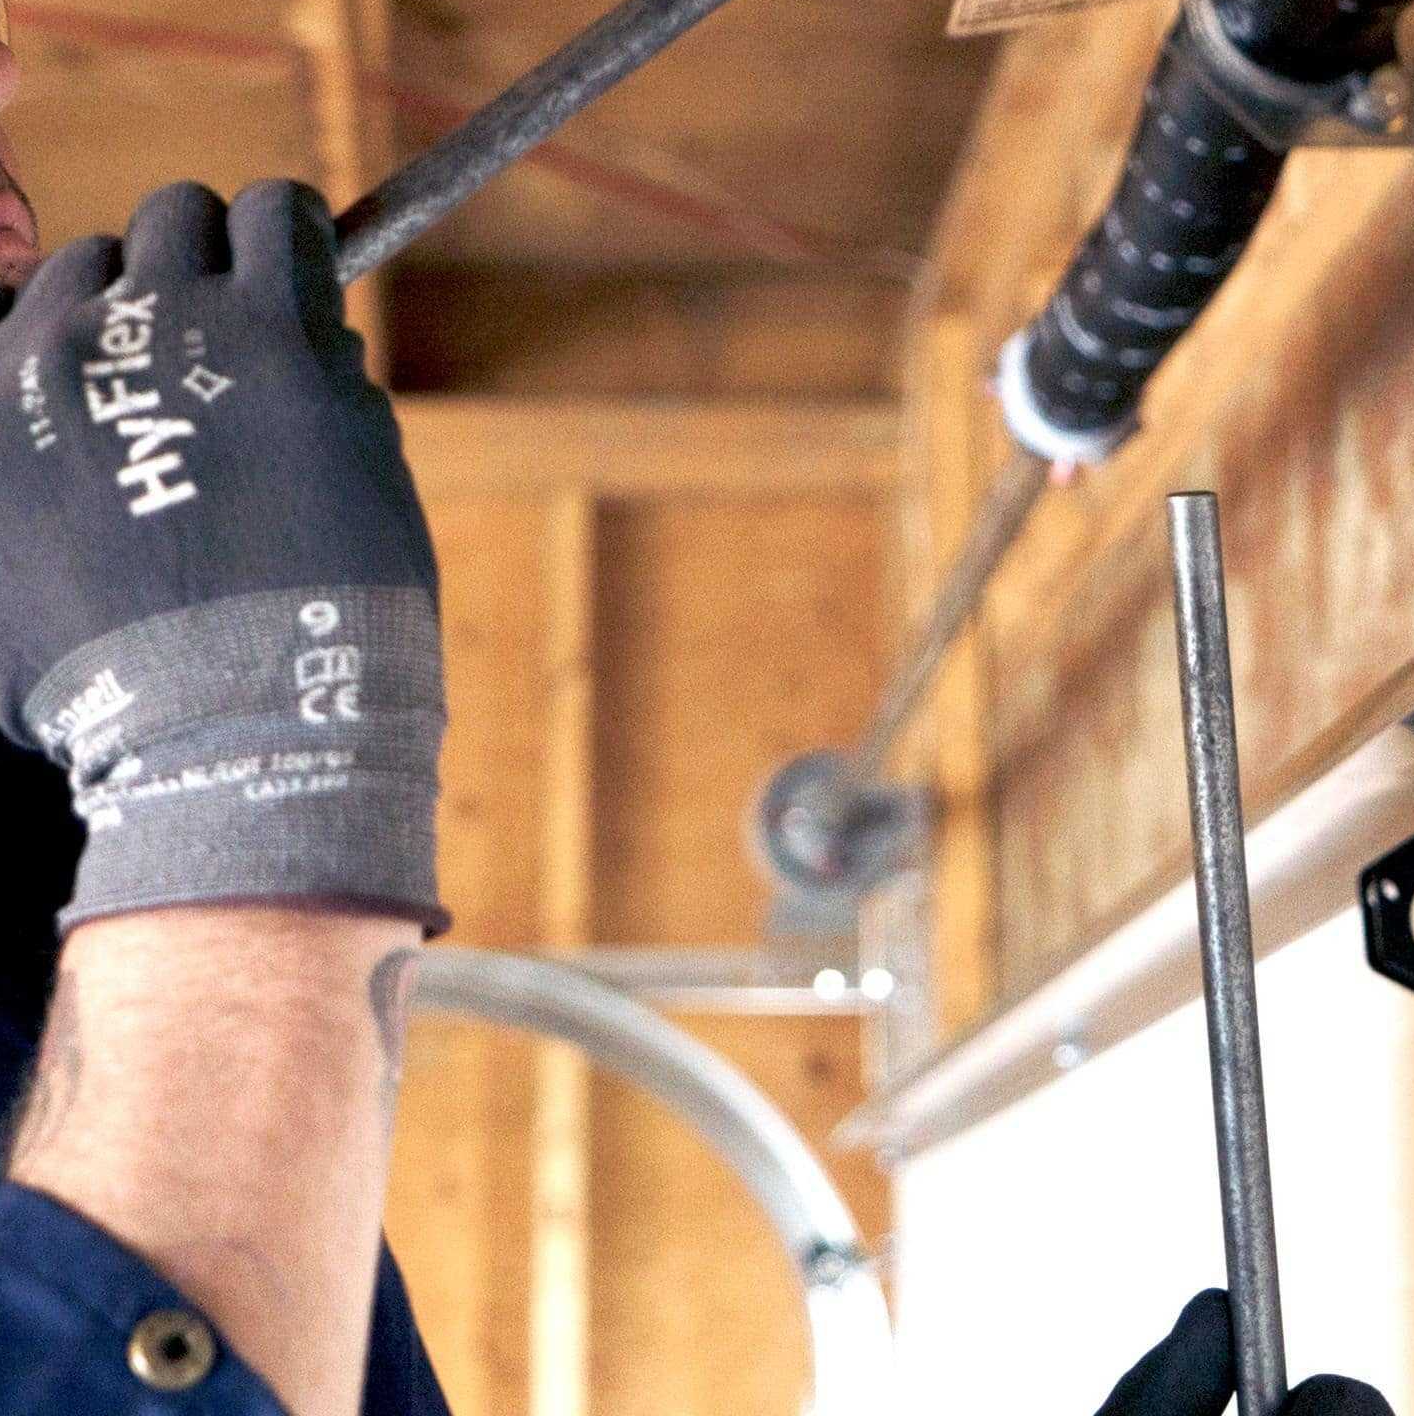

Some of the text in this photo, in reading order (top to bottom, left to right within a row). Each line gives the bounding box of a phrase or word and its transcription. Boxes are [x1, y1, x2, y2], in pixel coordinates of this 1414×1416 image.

[84, 290, 198, 518] HyFlex
[298, 600, 339, 637] 9
[299, 684, 362, 724] CE
